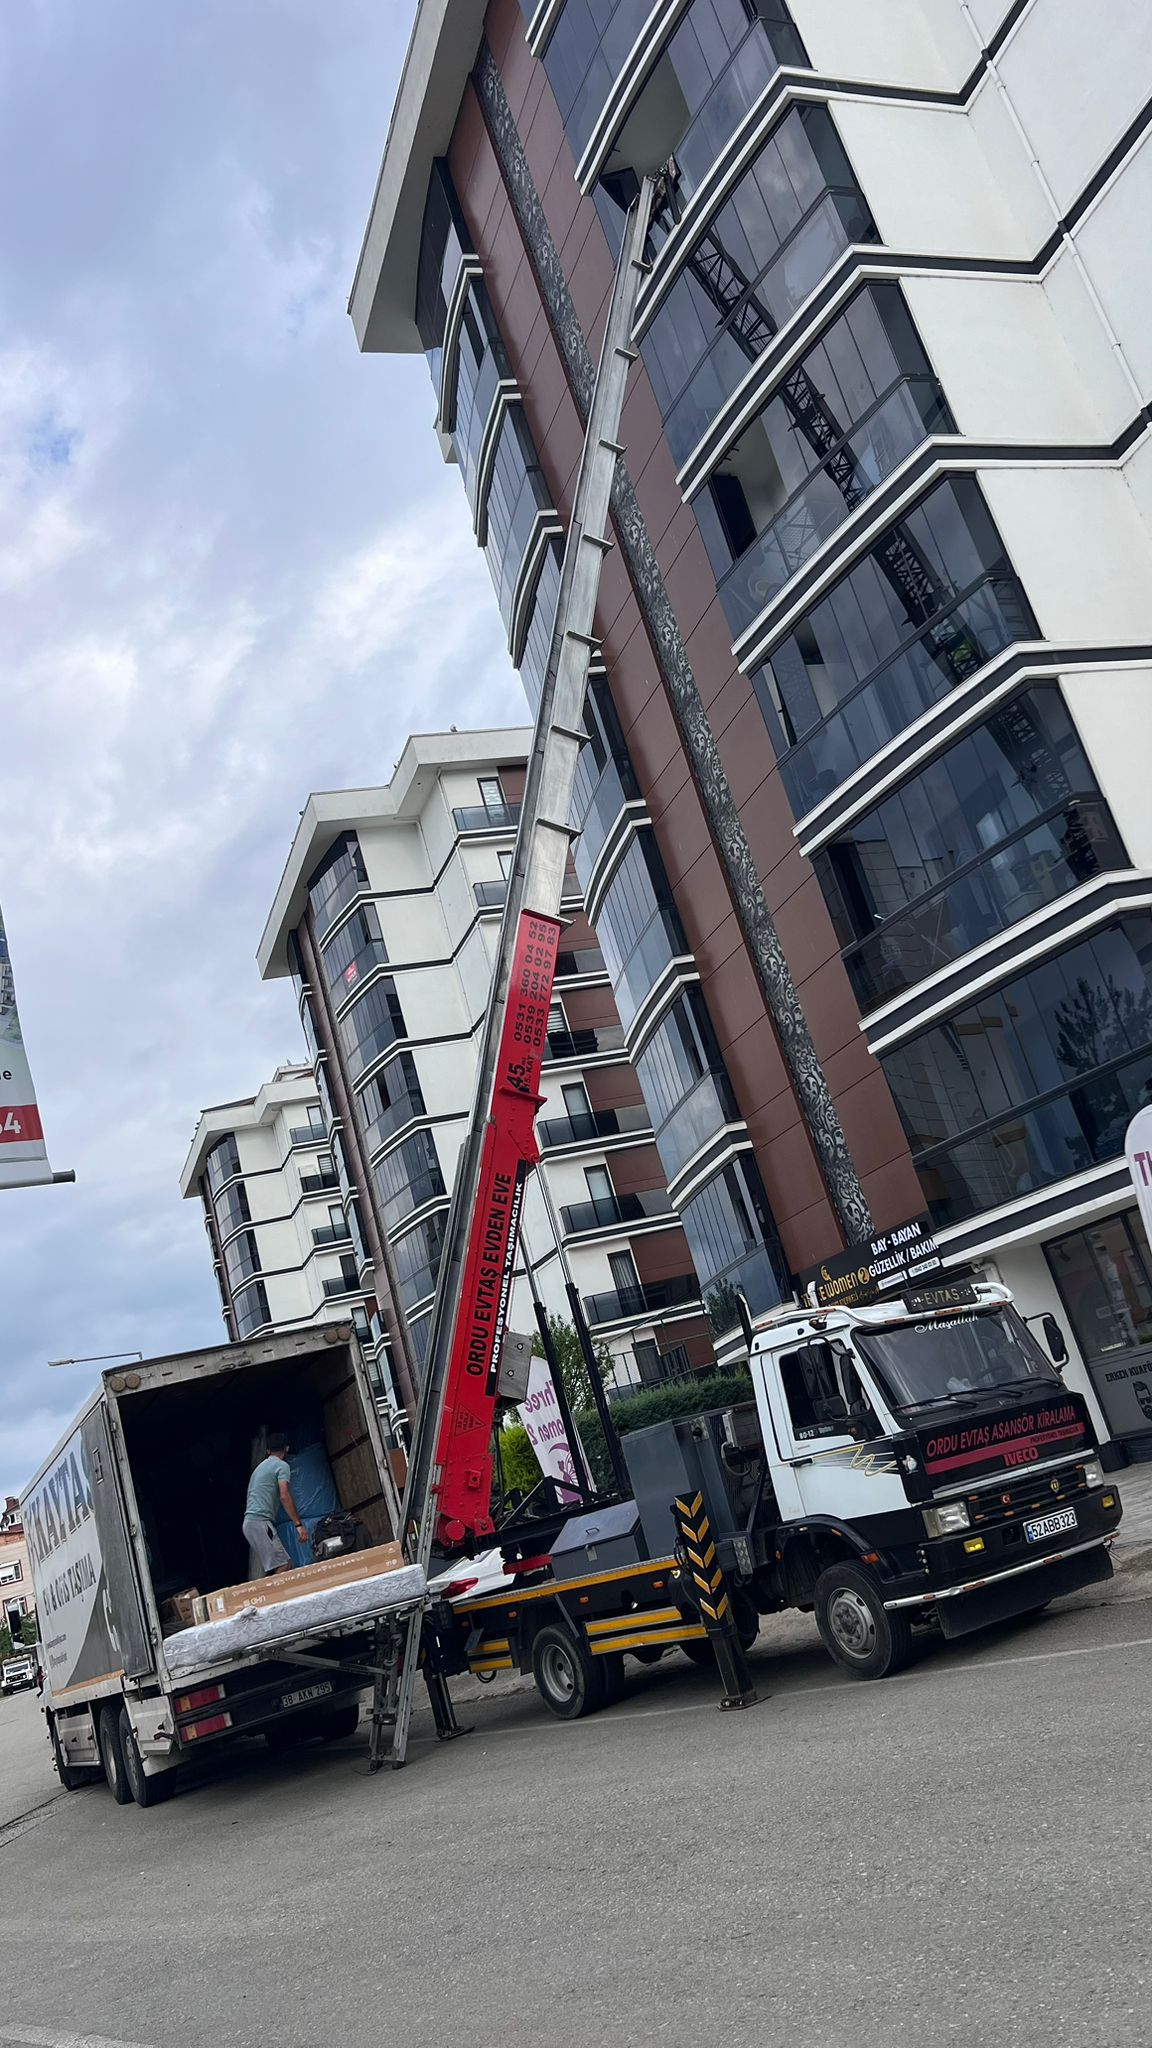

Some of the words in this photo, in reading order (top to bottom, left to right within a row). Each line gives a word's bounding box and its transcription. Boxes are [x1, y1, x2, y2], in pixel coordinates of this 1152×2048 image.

[528, 920, 539, 939] 52
[537, 923, 547, 942] 95
[547, 926, 557, 945] 83
[525, 944, 535, 964] 04
[534, 947, 544, 967] 02
[543, 951, 553, 970] 97
[519, 968, 531, 997] 360
[529, 973, 540, 1001] 204
[539, 975, 550, 1002] 772
[513, 1004, 526, 1042] 0531
[523, 1005, 536, 1045] 0539
[533, 1007, 545, 1047] 0533
[525, 1055, 535, 1073] KAT
[492, 1171, 512, 1208] EVE
[483, 1209, 506, 1265] EVDEN
[870, 1238, 887, 1256] BAY
[891, 1222, 921, 1247] BAYAN
[489, 1271, 510, 1374] PROFESYONEL
[504, 1182, 523, 1270] TAŞIMACILIK
[868, 1251, 906, 1278] GÜZELLİK
[474, 1270, 500, 1323] EVTAŞ
[914, 1313, 979, 1334] Maşallah
[466, 1325, 489, 1377] ORDU
[926, 1435, 958, 1458] ORDU
[960, 1426, 990, 1446] EVTAŞ
[991, 1411, 1035, 1441] ASANSÖR
[1037, 1404, 1077, 1430] KİRALAMA
[1003, 1446, 1040, 1467] IVECO
